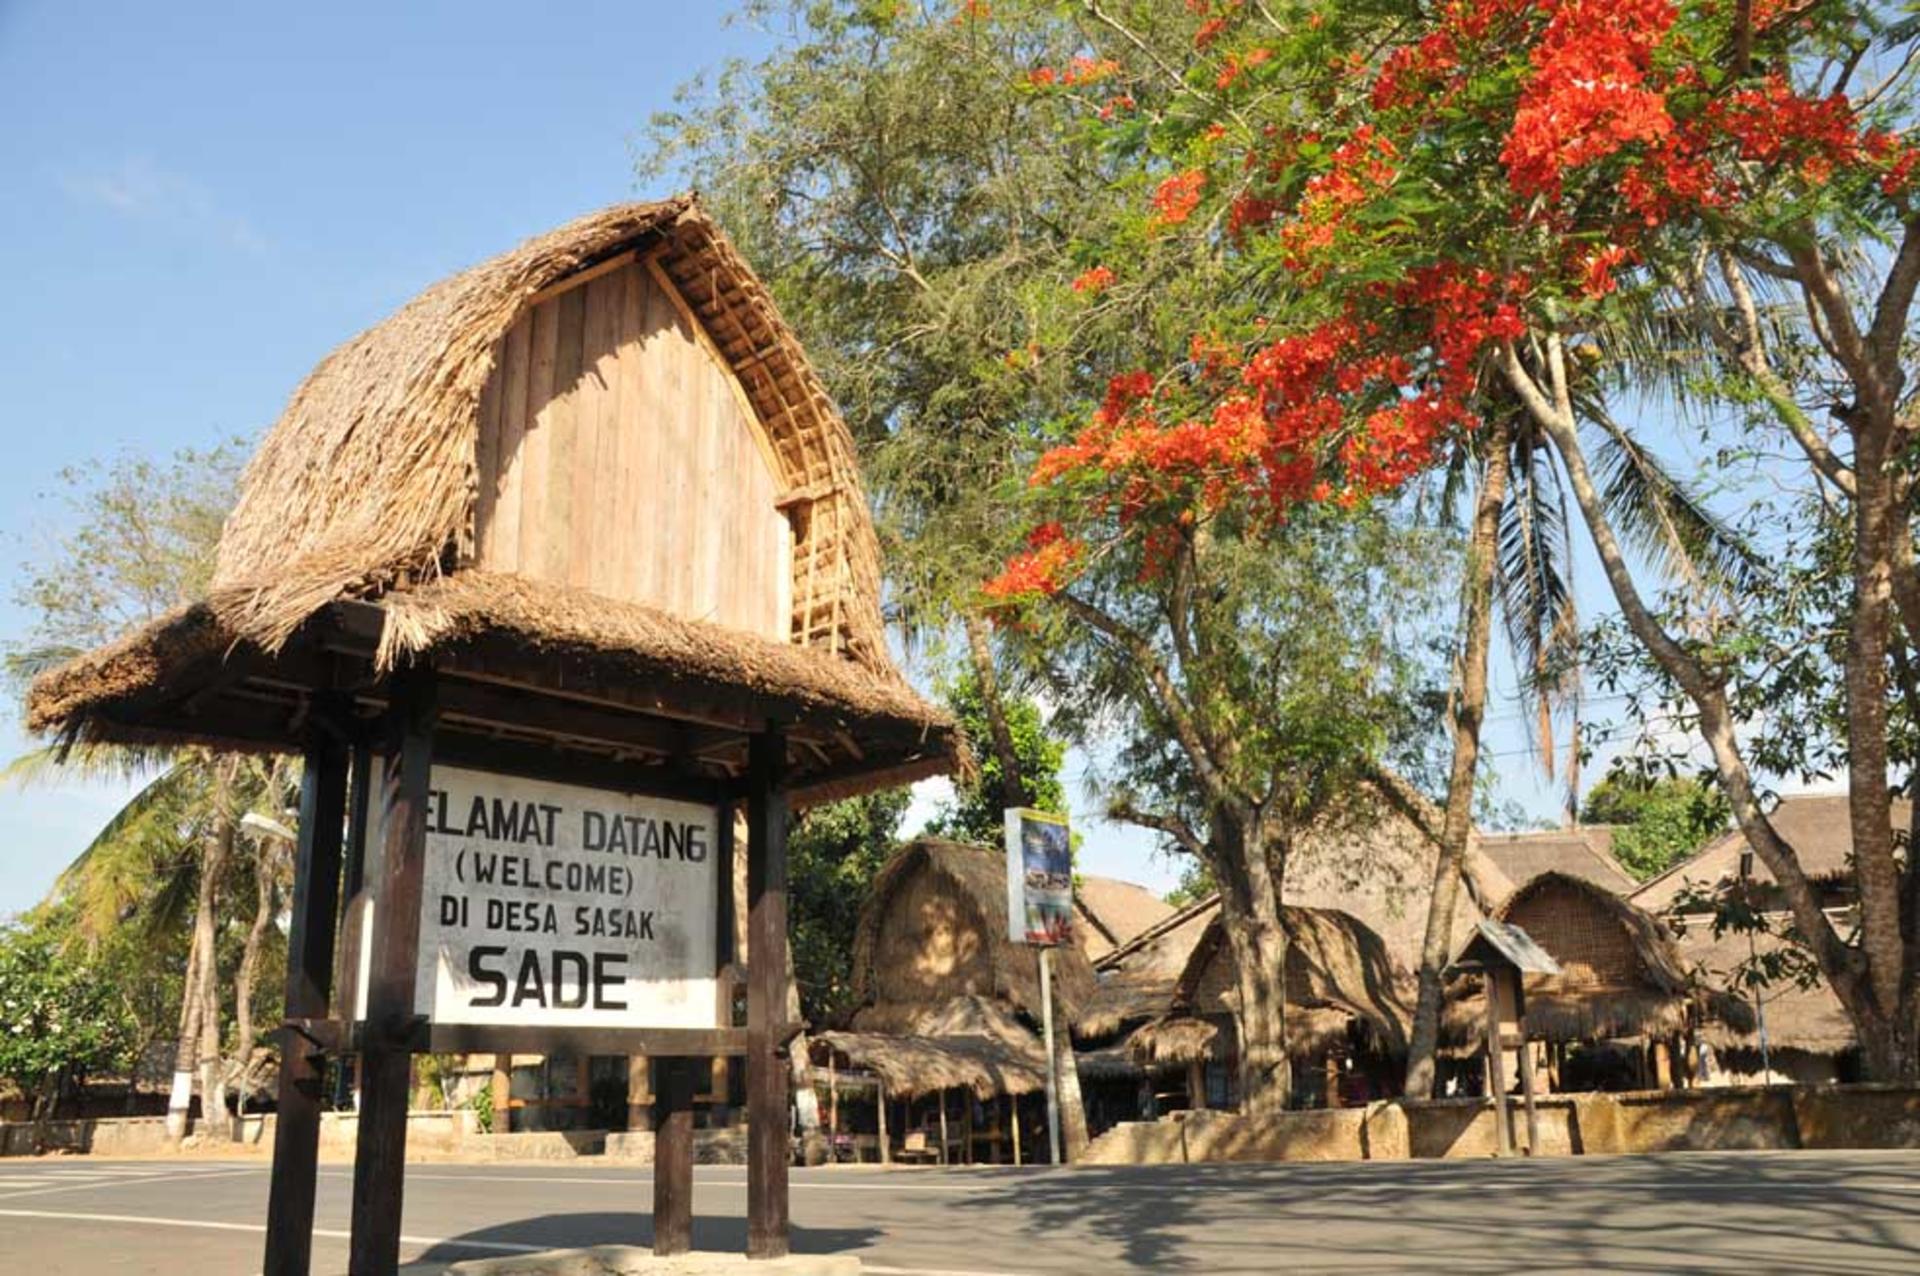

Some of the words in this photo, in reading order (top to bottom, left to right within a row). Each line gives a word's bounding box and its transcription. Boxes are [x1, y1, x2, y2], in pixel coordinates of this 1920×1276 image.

[425, 791, 562, 846] ELAMAT
[582, 810, 707, 863] DATANG
[456, 850, 633, 896] (WELCOME)
[440, 895, 468, 927] DI
[487, 899, 558, 933] DESA
[575, 906, 655, 940] SASAK
[468, 945, 629, 1010] SADE
